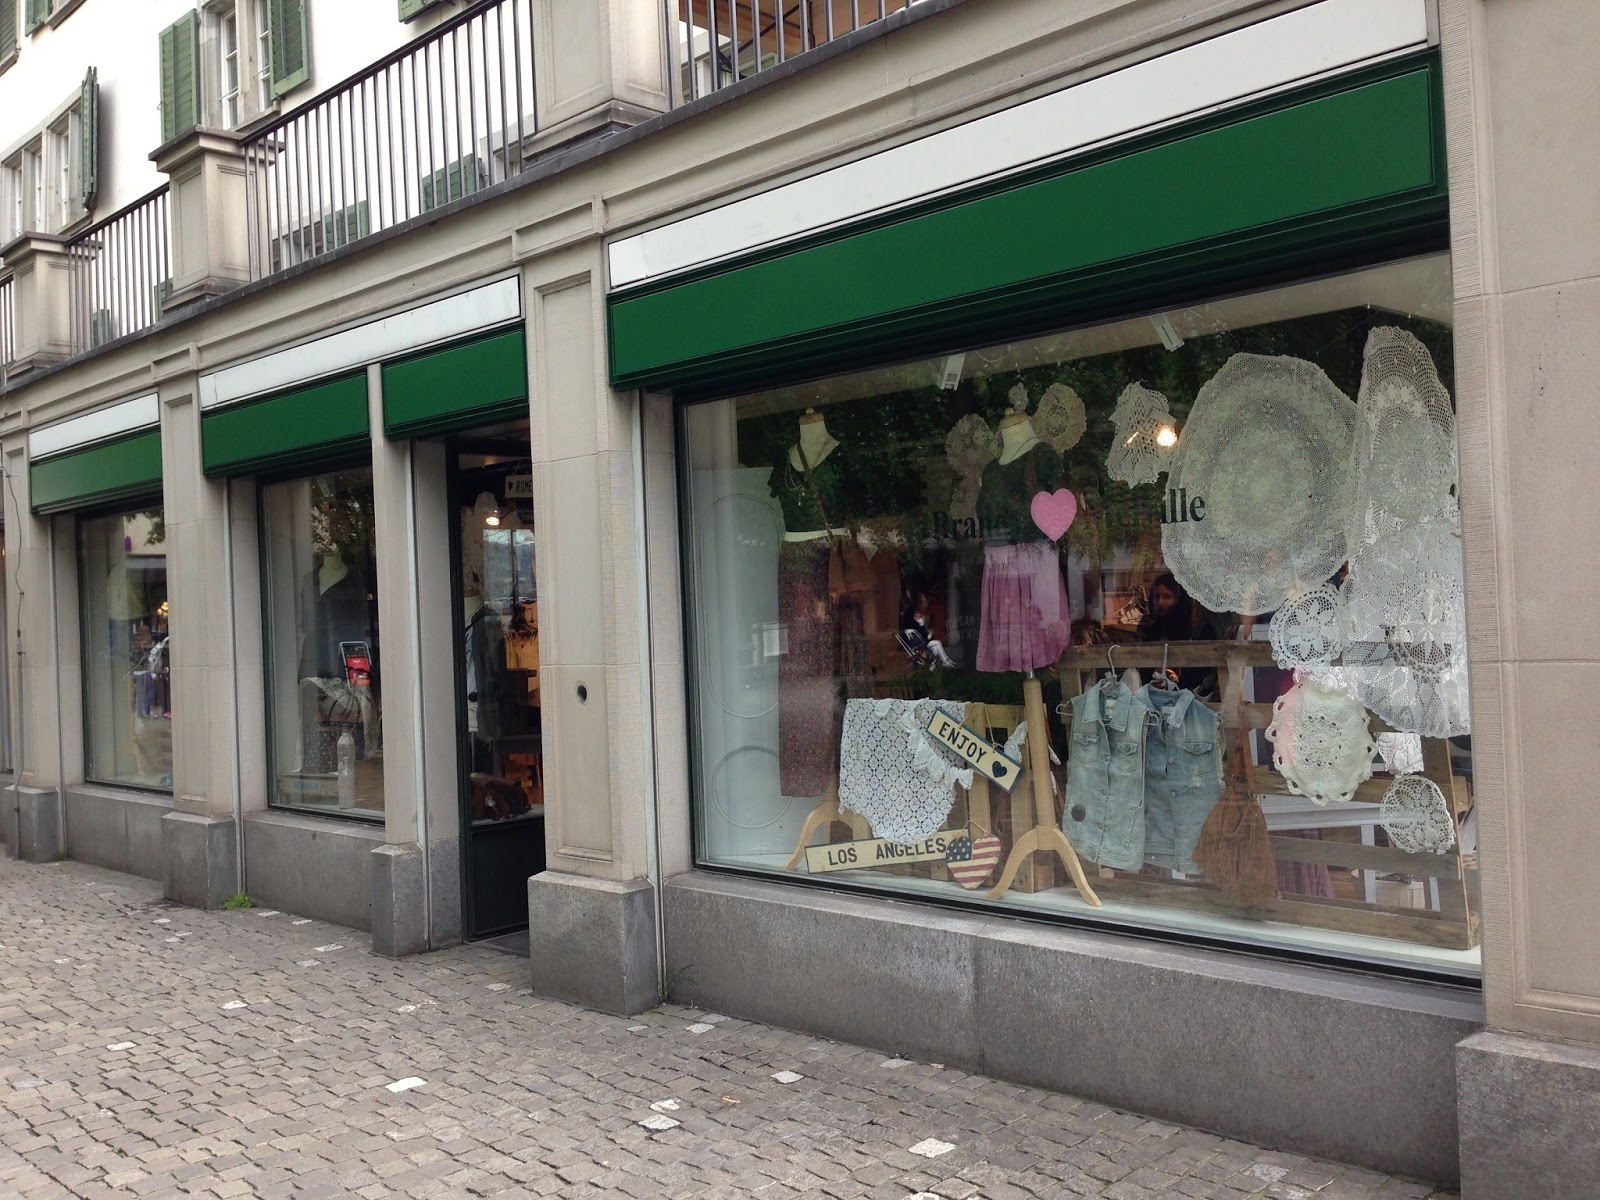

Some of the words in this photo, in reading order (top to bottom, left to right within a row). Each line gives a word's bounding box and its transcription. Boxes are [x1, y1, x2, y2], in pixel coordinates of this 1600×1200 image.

[938, 721, 987, 764] ENJOY
[827, 847, 858, 866] LOS
[876, 838, 947, 859] ANGELES
